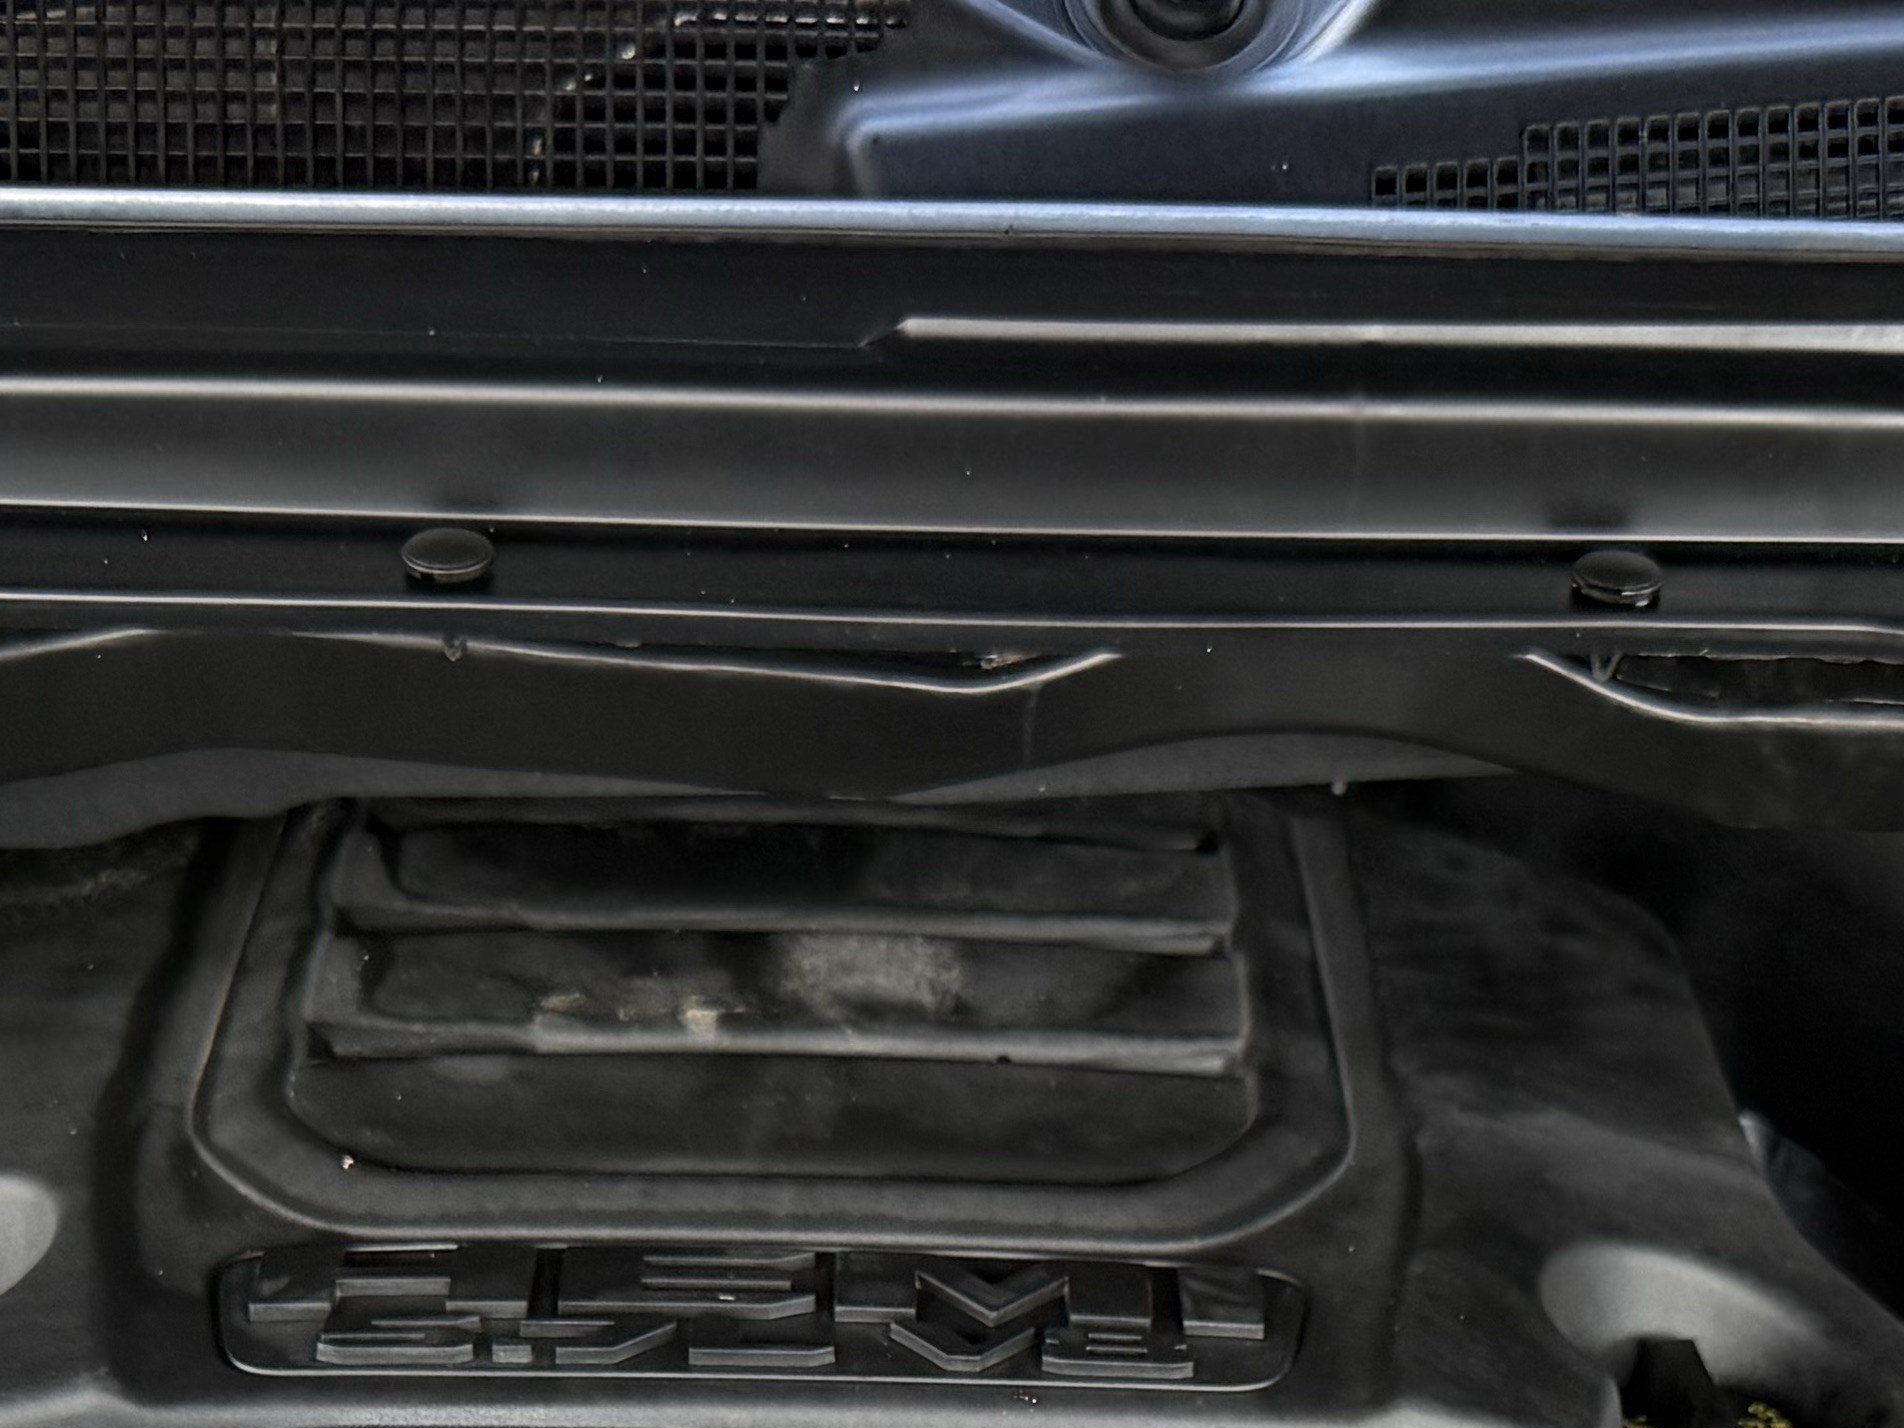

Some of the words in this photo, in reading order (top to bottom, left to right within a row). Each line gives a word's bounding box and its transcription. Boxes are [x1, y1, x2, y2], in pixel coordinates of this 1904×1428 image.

[248, 1244, 1264, 1339] HEMI
[315, 1313, 836, 1367] 5.7L
[891, 1320, 1194, 1379] V8
